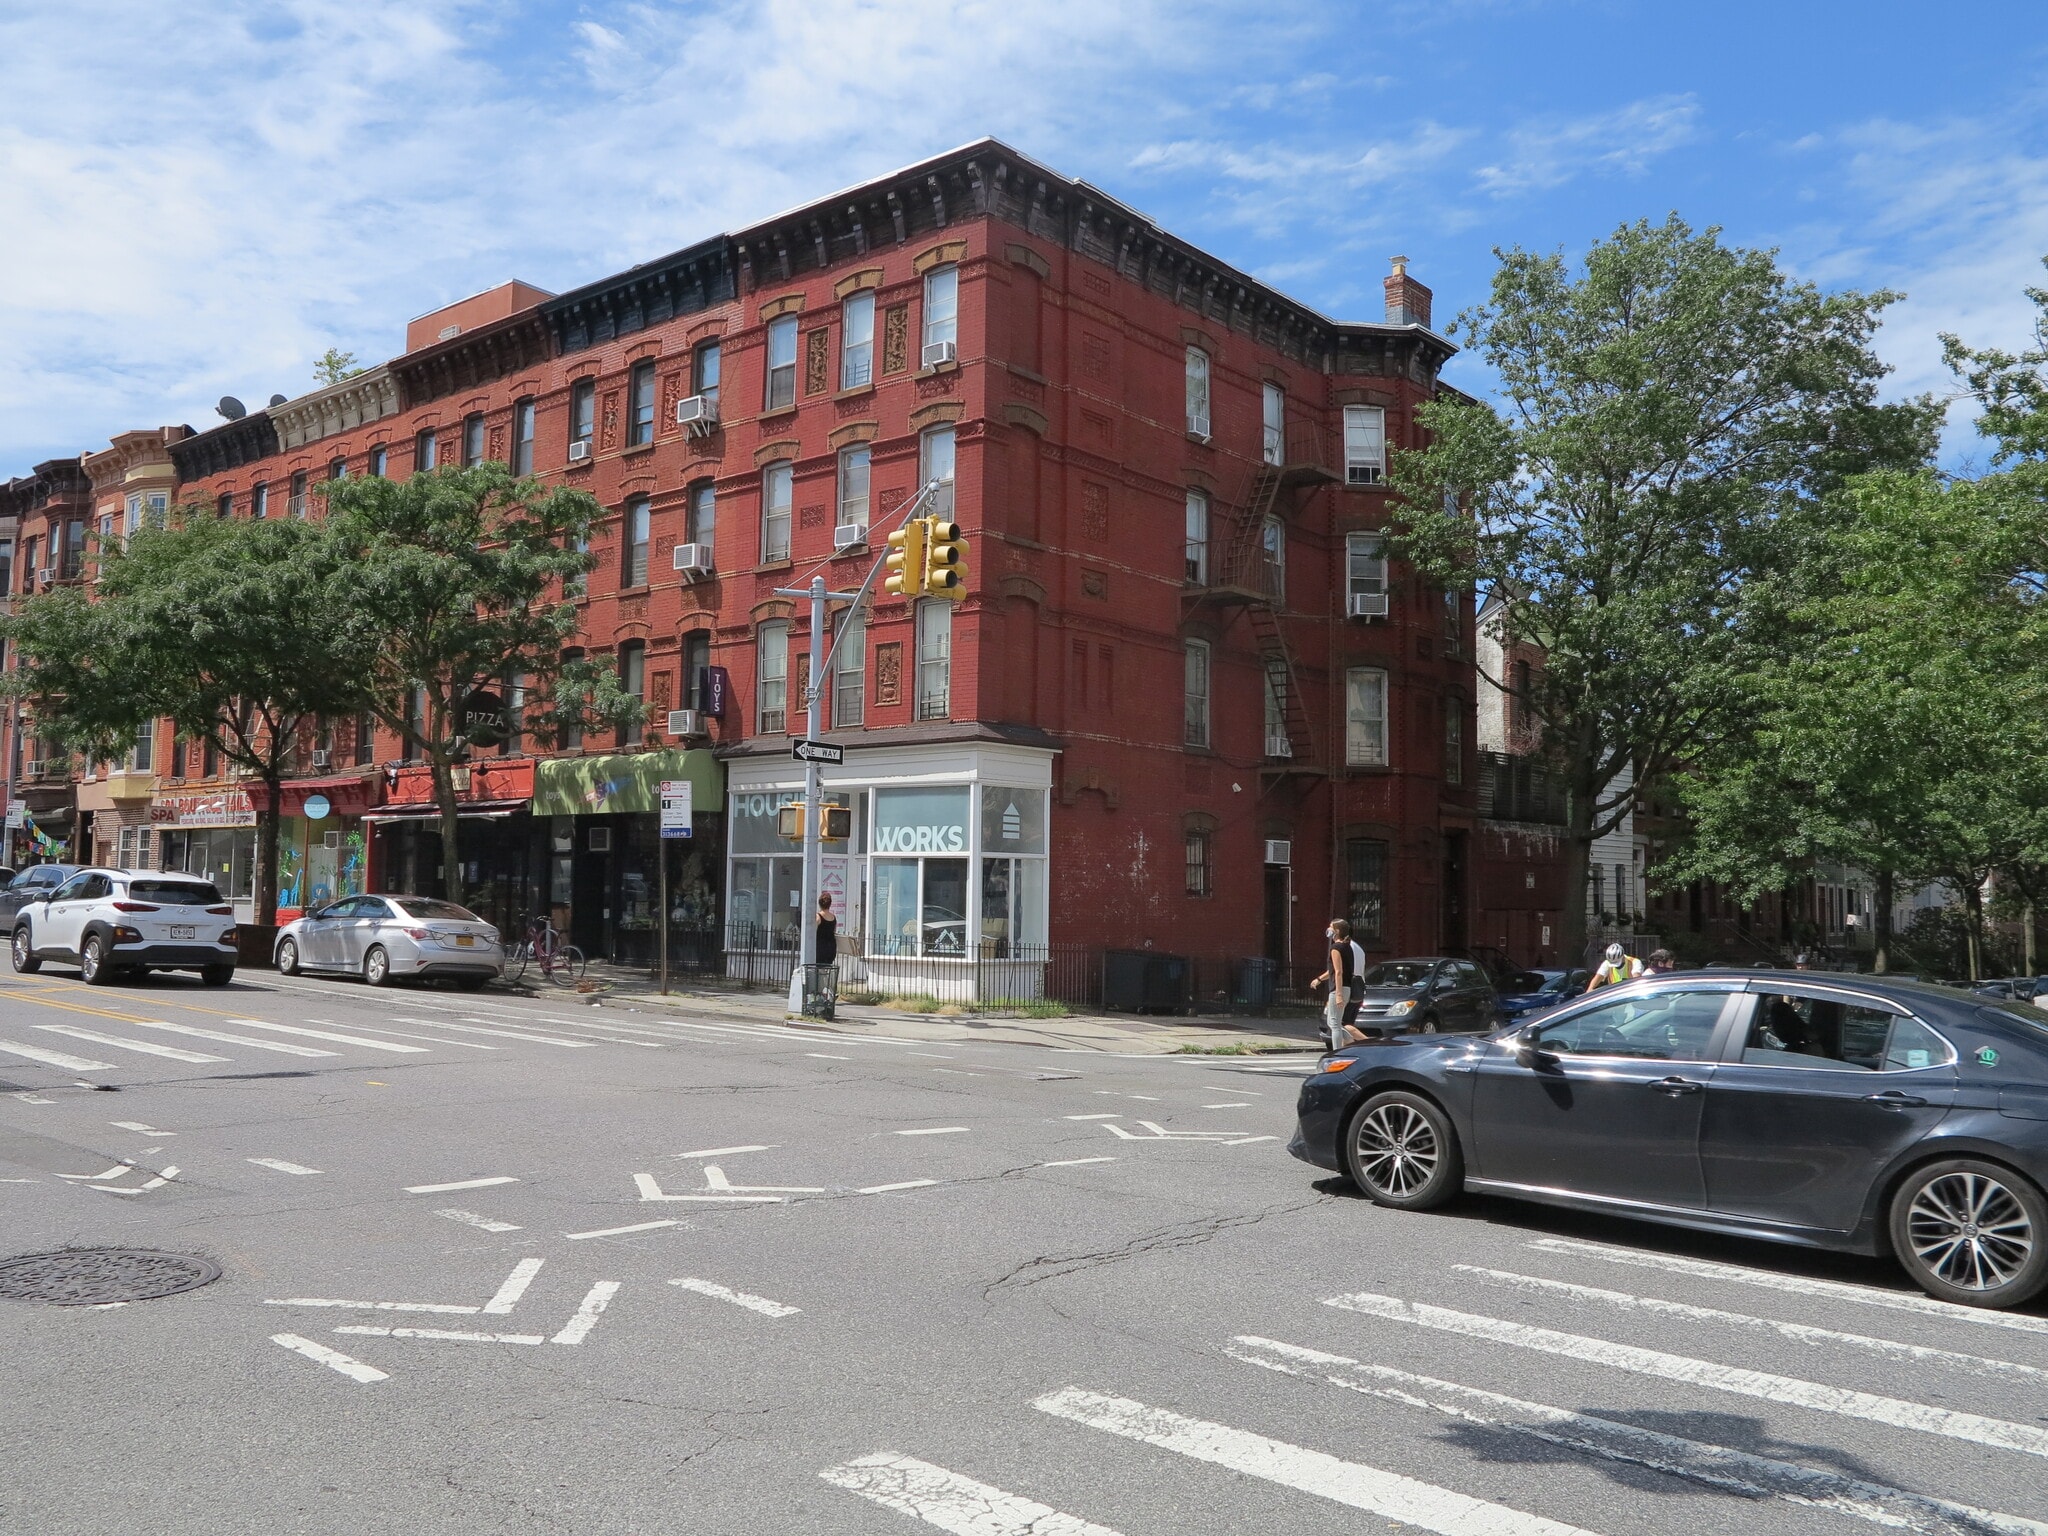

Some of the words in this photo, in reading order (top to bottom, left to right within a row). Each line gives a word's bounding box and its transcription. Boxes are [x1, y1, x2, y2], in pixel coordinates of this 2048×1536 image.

[713, 673, 721, 712] TOYS
[465, 711, 505, 727] PIZZA
[800, 746, 816, 756] ONE
[822, 749, 838, 758] WAY
[545, 789, 561, 802] toys
[150, 809, 174, 821] SPA
[876, 826, 963, 852] WORKS
